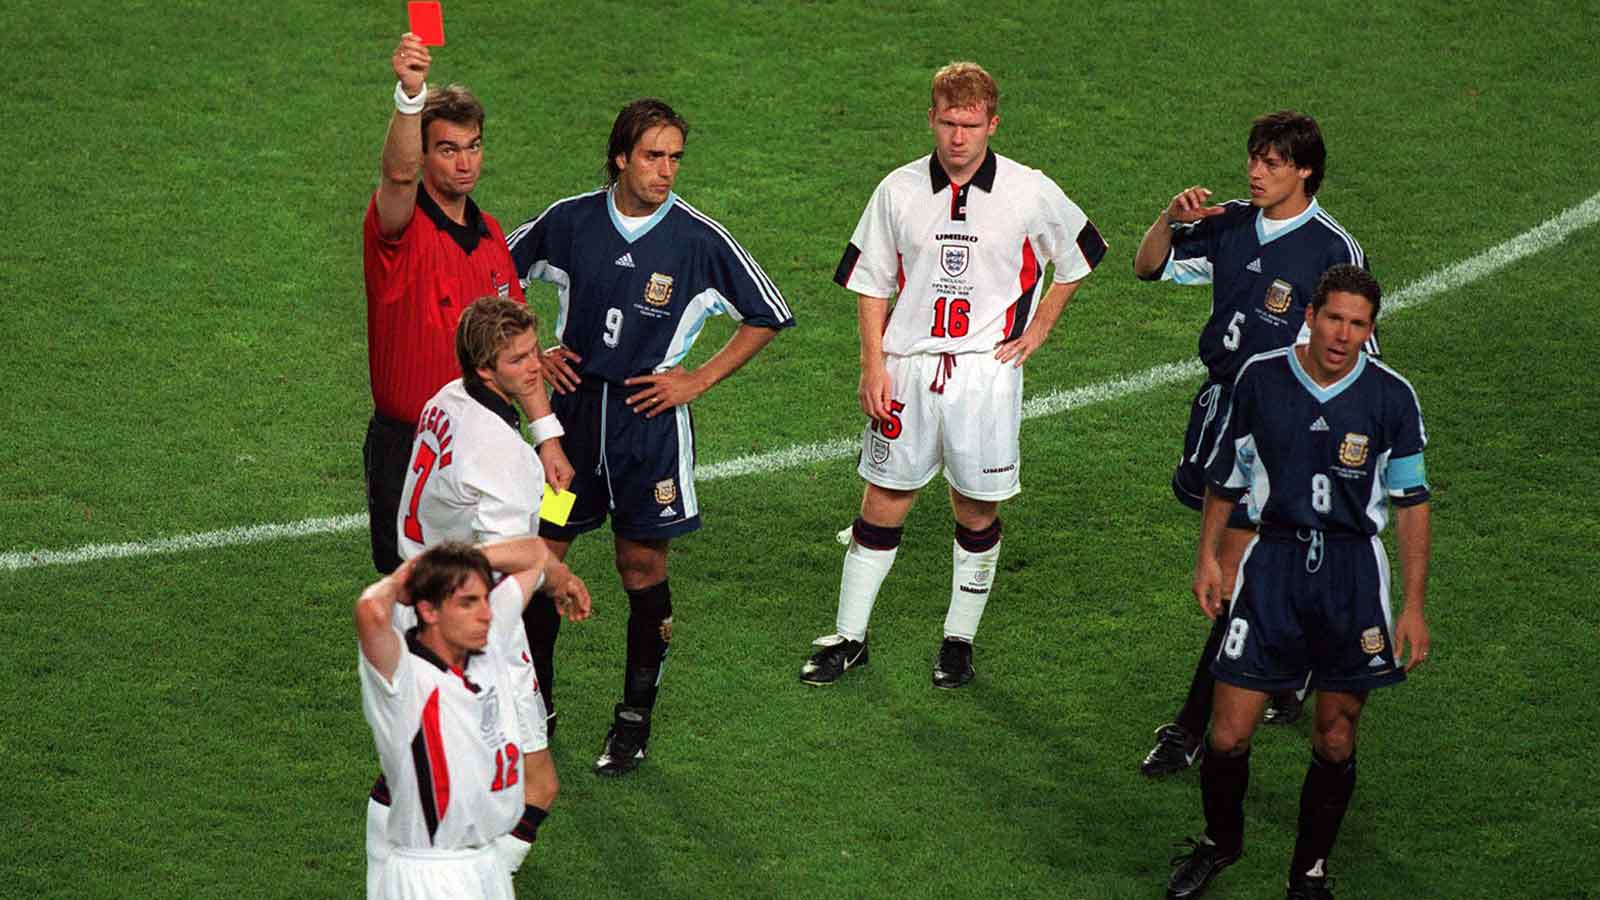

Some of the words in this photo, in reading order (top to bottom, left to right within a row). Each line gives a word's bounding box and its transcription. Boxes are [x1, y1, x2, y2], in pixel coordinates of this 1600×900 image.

[935, 233, 978, 242] UMBRO
[603, 307, 624, 349] 9
[930, 296, 971, 338] 16
[1223, 311, 1246, 351] 5
[983, 464, 1015, 475] UMBRO
[404, 440, 438, 545] 7
[1311, 473, 1332, 514] 8
[1224, 617, 1249, 660] 8
[490, 742, 520, 792] 12
